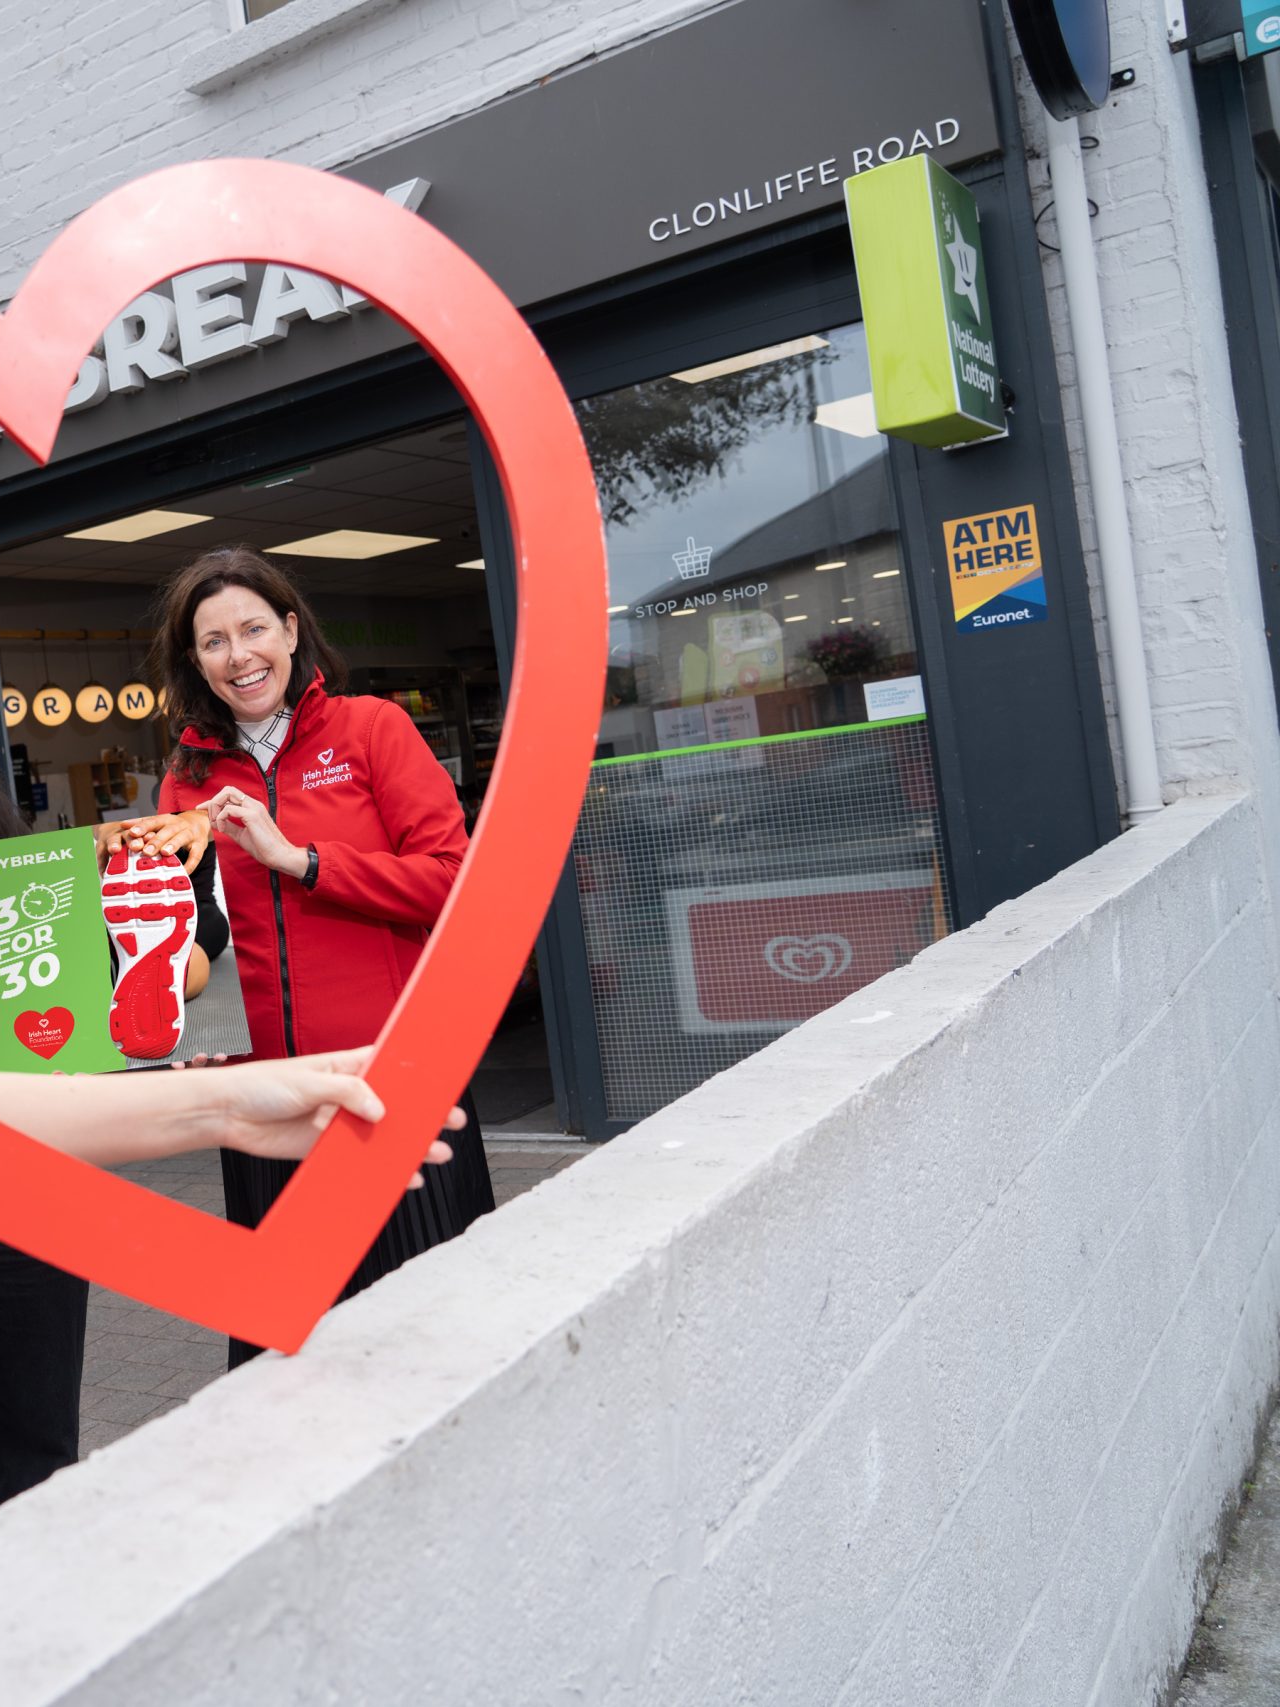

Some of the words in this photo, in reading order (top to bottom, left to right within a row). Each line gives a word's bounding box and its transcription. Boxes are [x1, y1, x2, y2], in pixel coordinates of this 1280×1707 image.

[648, 158, 840, 242] CLONLIFFE
[852, 117, 960, 173] ROAD
[951, 319, 995, 367] National
[959, 354, 995, 403] Lottery
[952, 510, 1031, 549] ATM
[953, 539, 1034, 573] HERE
[635, 600, 677, 619] STOP
[683, 592, 717, 610] AND
[722, 582, 769, 602] SHOP
[972, 608, 1031, 627] Euronet
[302, 769, 322, 782] Irish
[323, 762, 351, 776] Heart
[302, 772, 353, 791] Foundation
[0, 952, 61, 1000] 30
[28, 1030, 42, 1038] Irish
[43, 1028, 62, 1036] Heart
[29, 1035, 64, 1044] Foundation
